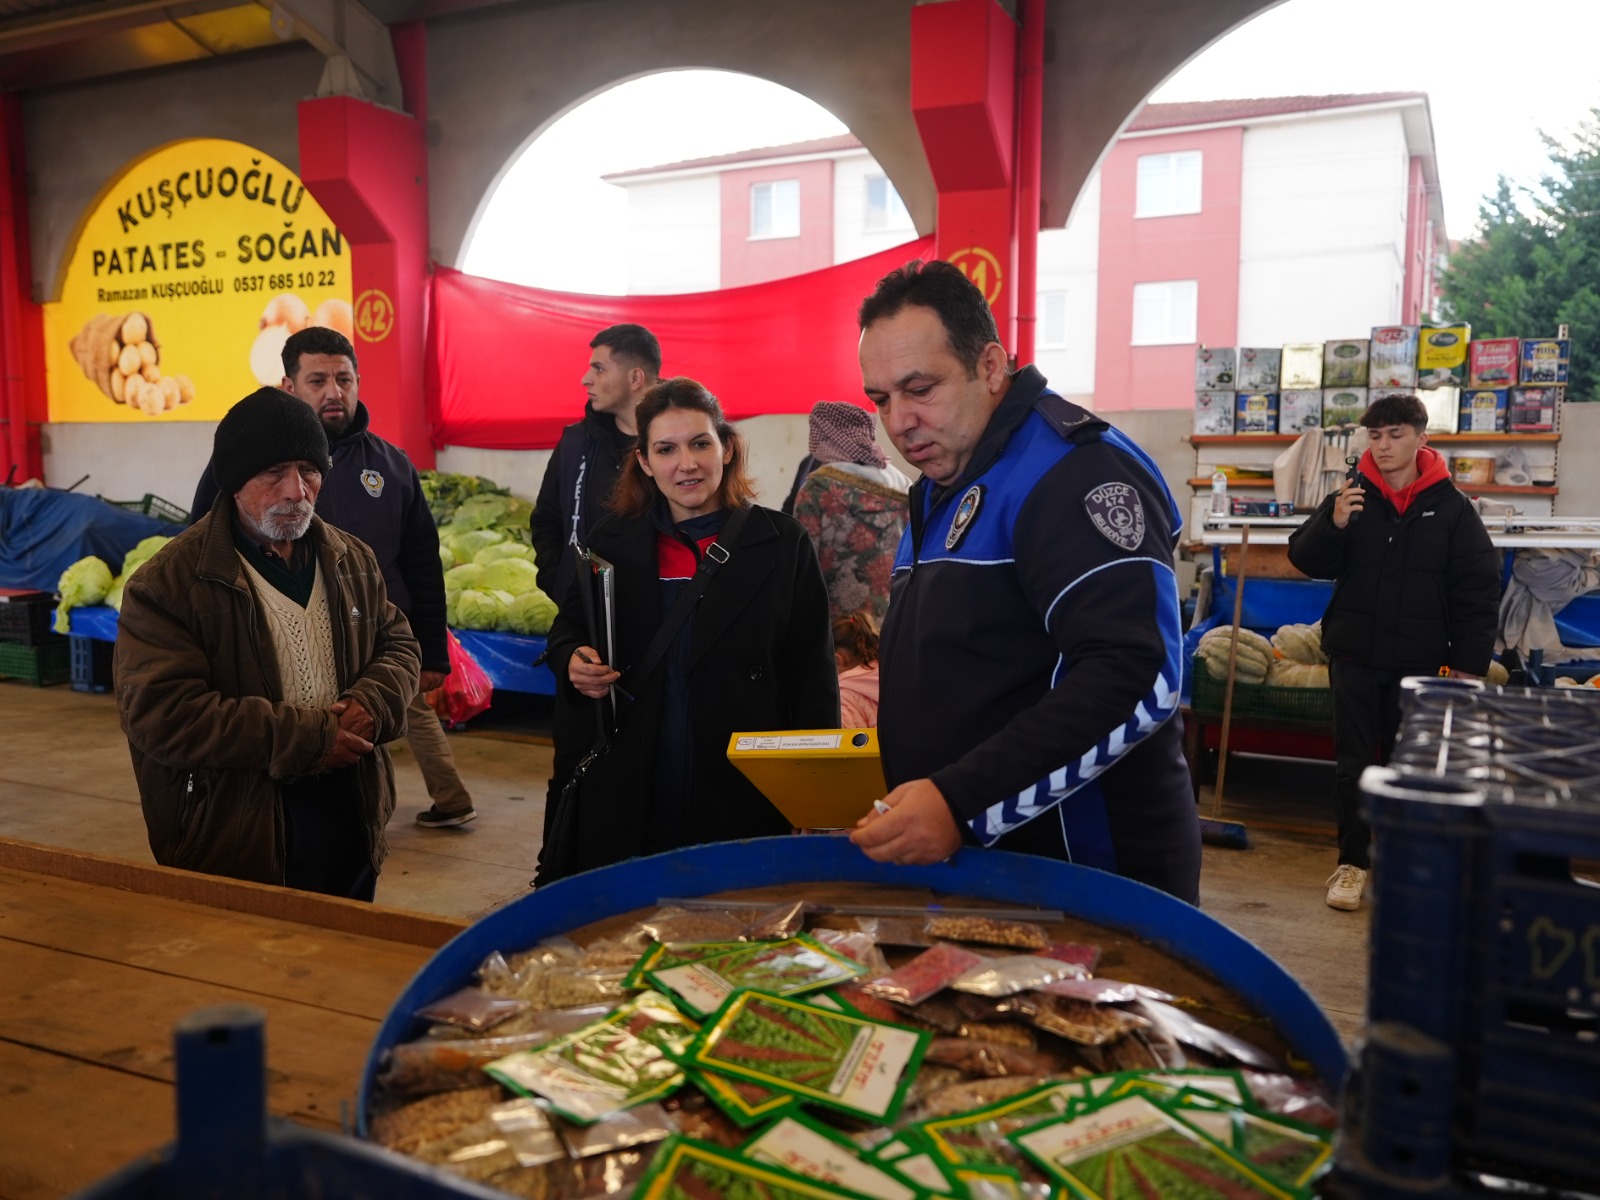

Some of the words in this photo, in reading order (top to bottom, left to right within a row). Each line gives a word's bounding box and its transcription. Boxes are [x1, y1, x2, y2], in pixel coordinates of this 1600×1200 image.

[118, 158, 304, 233] KUŞÇUOĞLU
[93, 240, 206, 276] PATATES
[237, 221, 342, 264] SOĞAN
[98, 288, 148, 302] Ramazan
[151, 275, 224, 302] KUŞÇUOĞLU
[234, 275, 264, 292] 0537
[269, 273, 294, 290] 685
[298, 271, 314, 288] 10
[318, 270, 335, 287] 22
[360, 299, 386, 333] 42
[1091, 485, 1130, 504] DÜZCE
